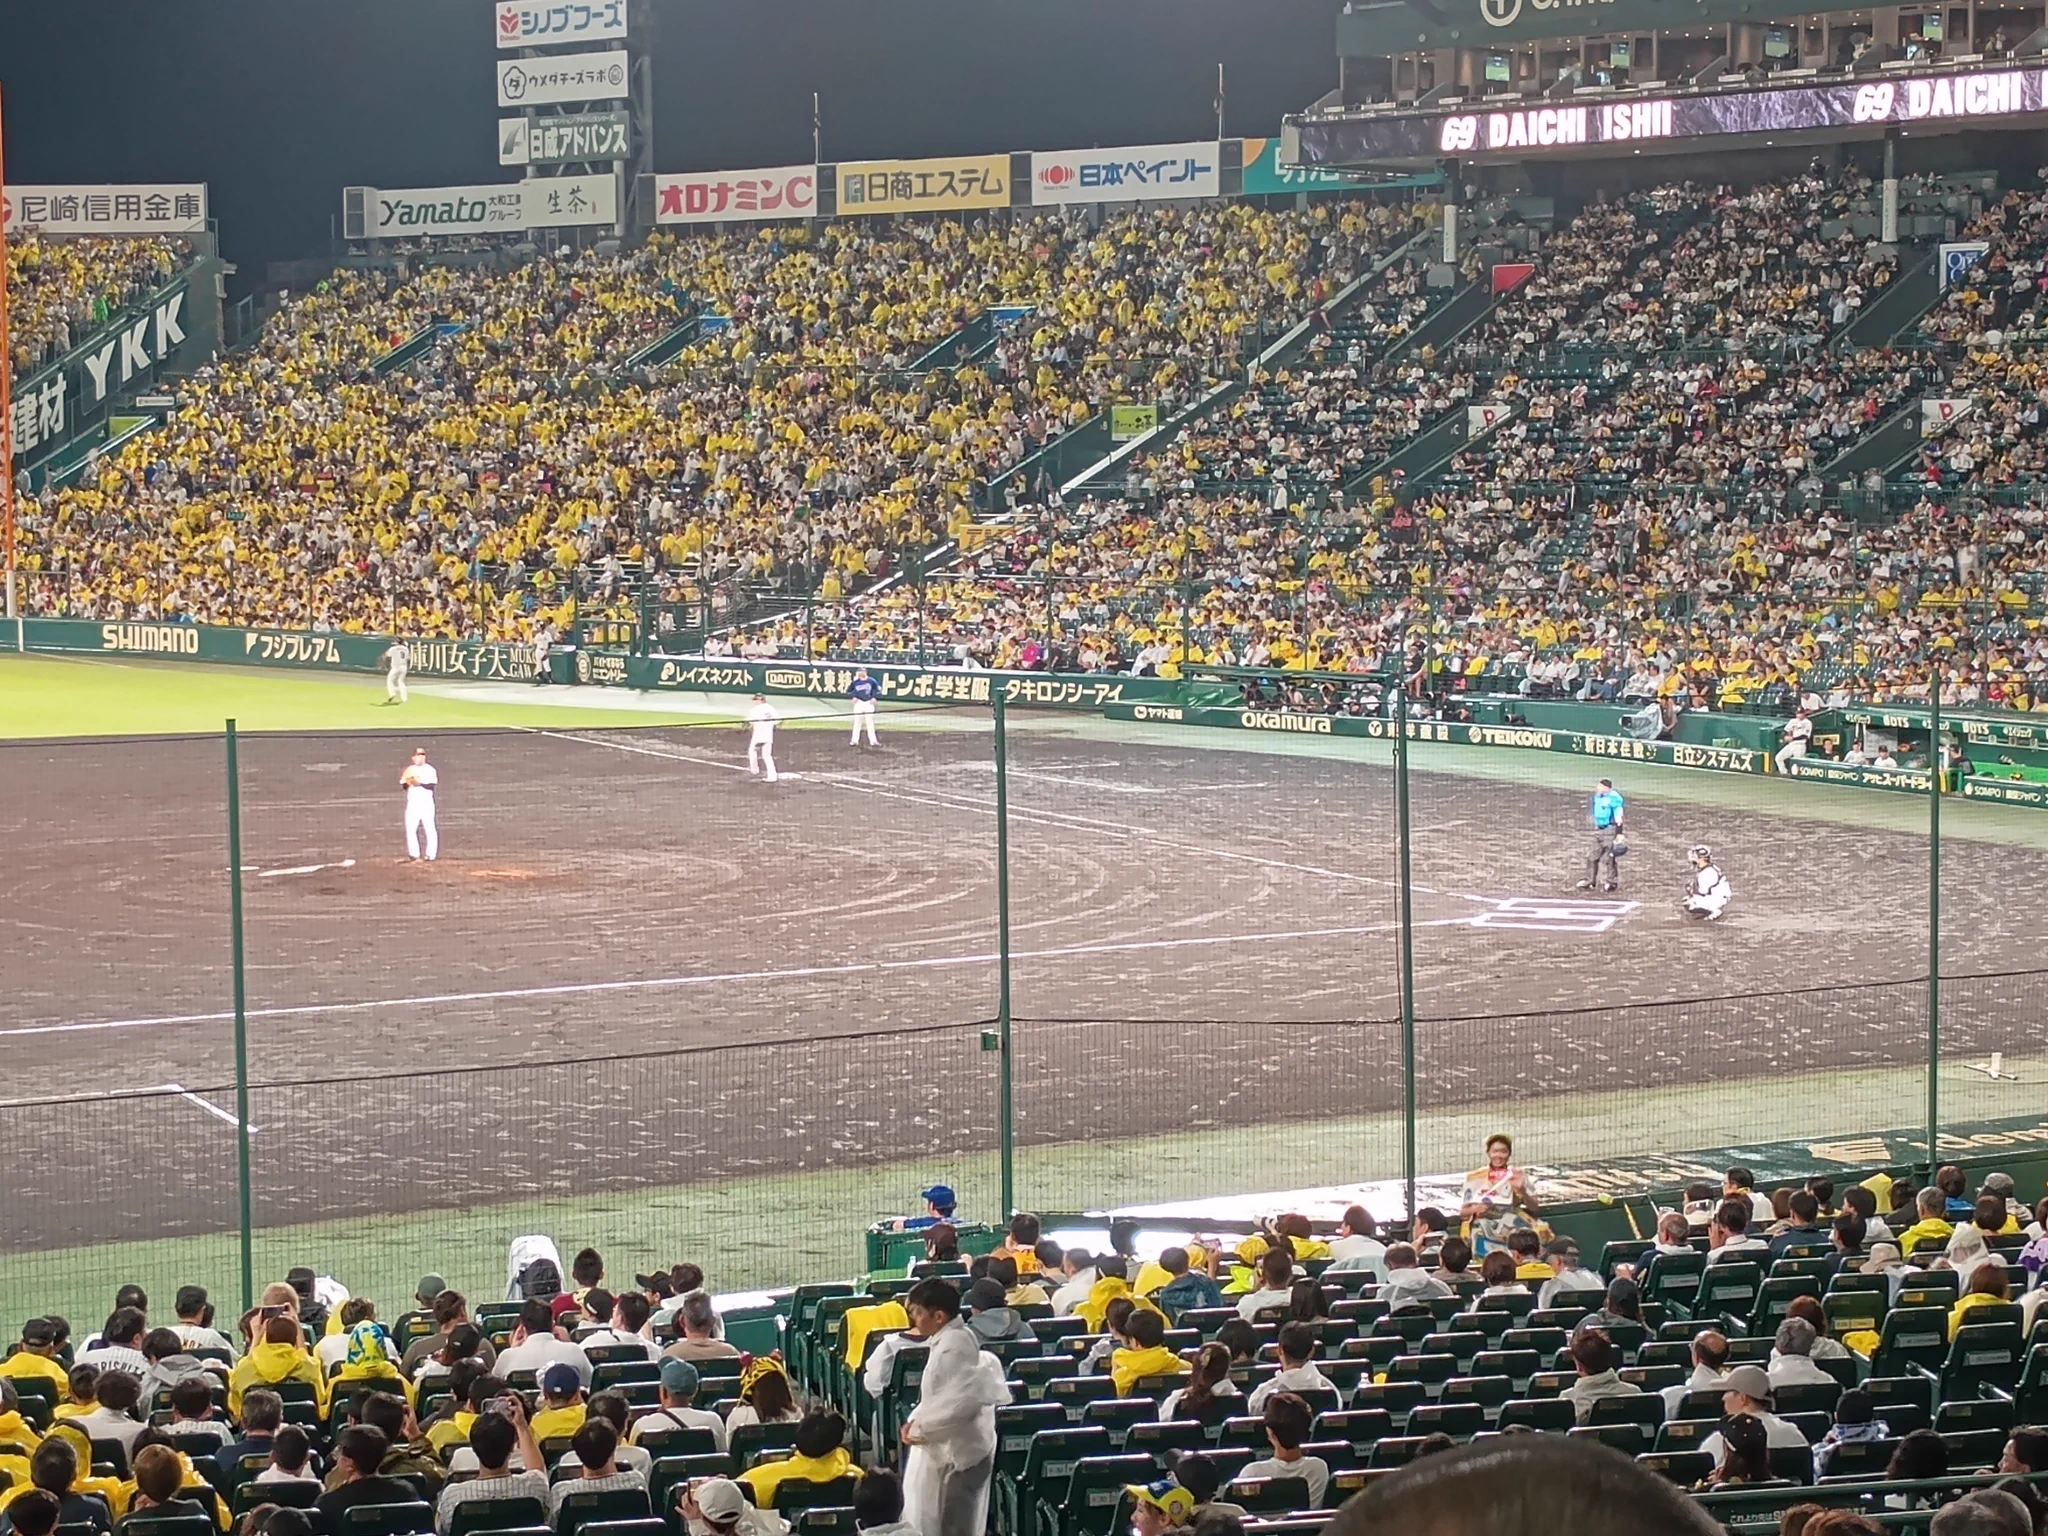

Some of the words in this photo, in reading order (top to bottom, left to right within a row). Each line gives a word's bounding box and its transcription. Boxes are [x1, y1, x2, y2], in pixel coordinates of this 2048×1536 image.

[521, 0, 623, 35] シノブフーズ
[529, 69, 607, 88] ウメダチーズラボ
[1853, 82, 1894, 122] 69
[1909, 71, 2022, 117] DAICHI
[1440, 115, 1478, 151] 69
[1489, 108, 1586, 148] DAICHI
[1603, 101, 1672, 140] ISHII
[868, 168, 1004, 202] 日商エステム
[1079, 158, 1211, 187] 日本ペイント
[20, 193, 200, 222] 尼崎信用金庫
[547, 185, 588, 214] 生茶
[659, 175, 813, 216] オロナミンC
[380, 196, 487, 226] Yamato
[84, 291, 187, 401] YKK
[0, 372, 67, 458] 建材
[102, 624, 199, 654] SHIMANO
[676, 665, 753, 686] レイズネクスト
[769, 673, 802, 685] DAITO
[881, 673, 990, 701] トンボ学生服
[1005, 679, 1124, 705] タキロンシーアイ
[1483, 729, 1552, 748] TEIKOKU
[1673, 746, 1753, 772] 日立システムズ
